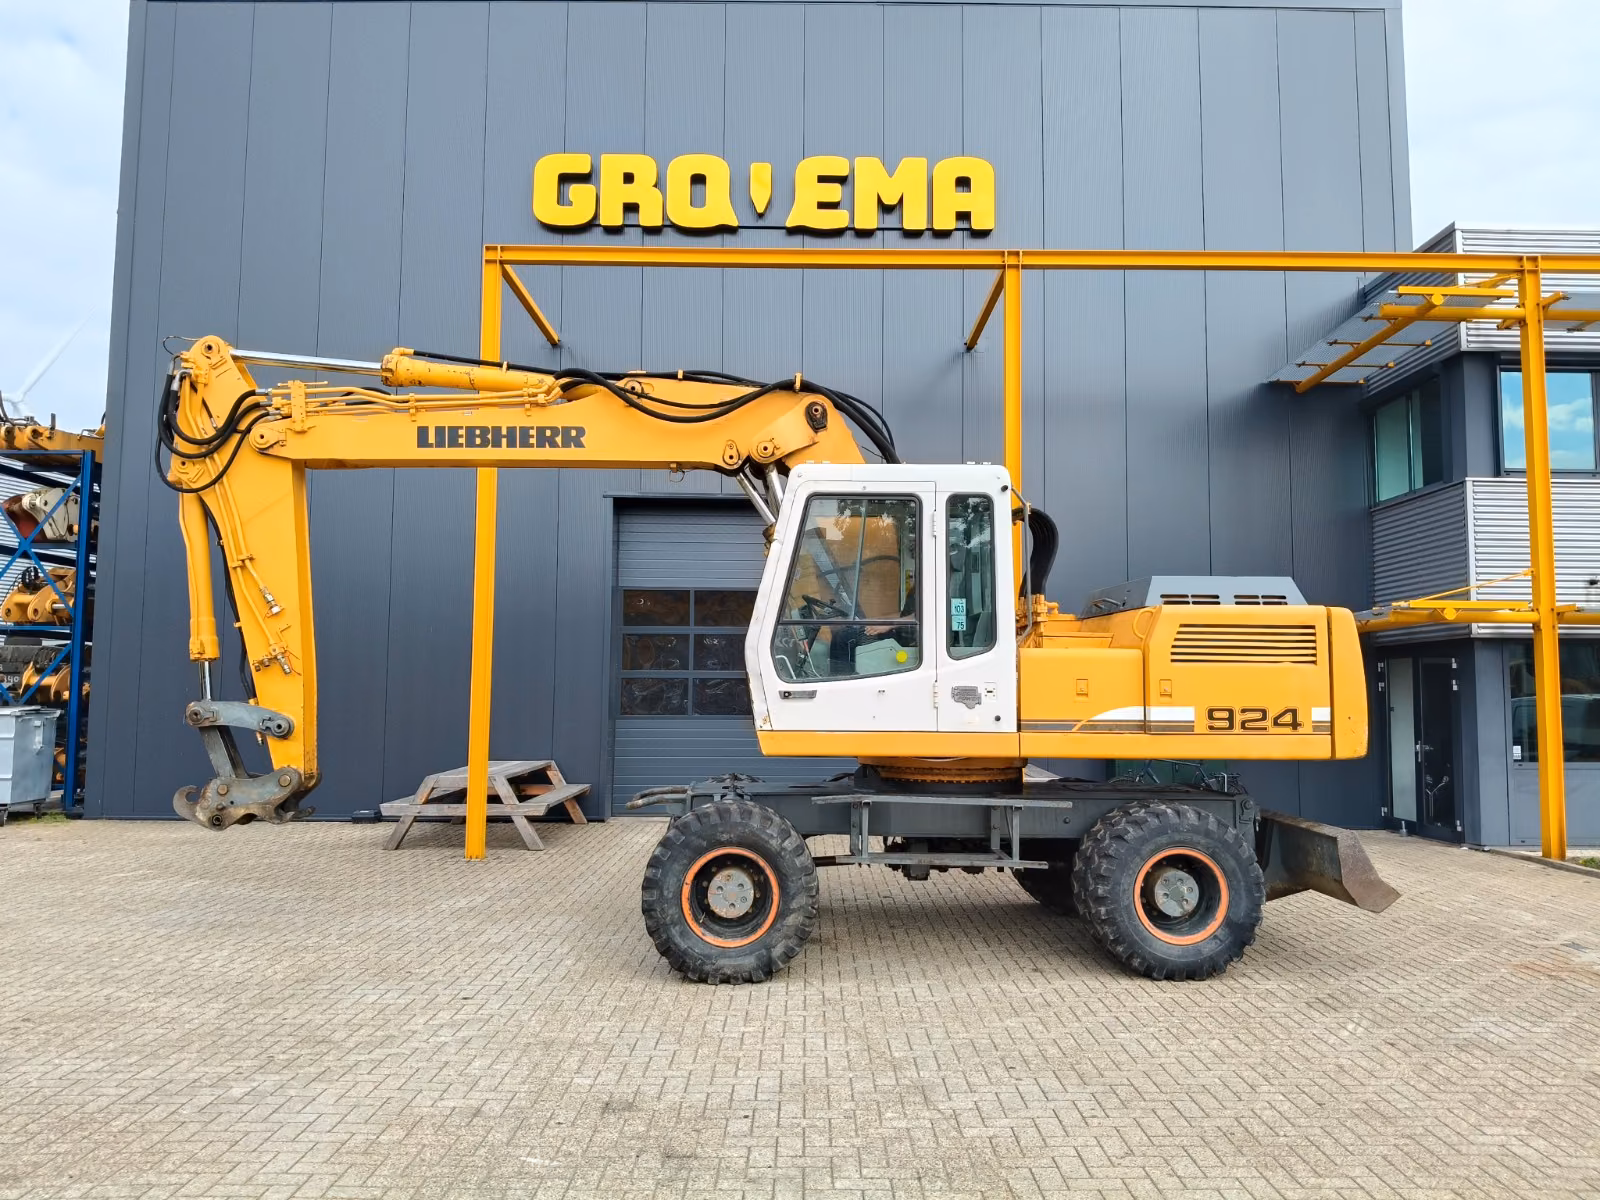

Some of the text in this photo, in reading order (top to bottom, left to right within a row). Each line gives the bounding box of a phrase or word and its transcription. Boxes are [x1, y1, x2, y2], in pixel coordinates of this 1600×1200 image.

[417, 426, 586, 448] LIEBHERR
[956, 621, 965, 630] 75
[1206, 706, 1304, 732] 924
